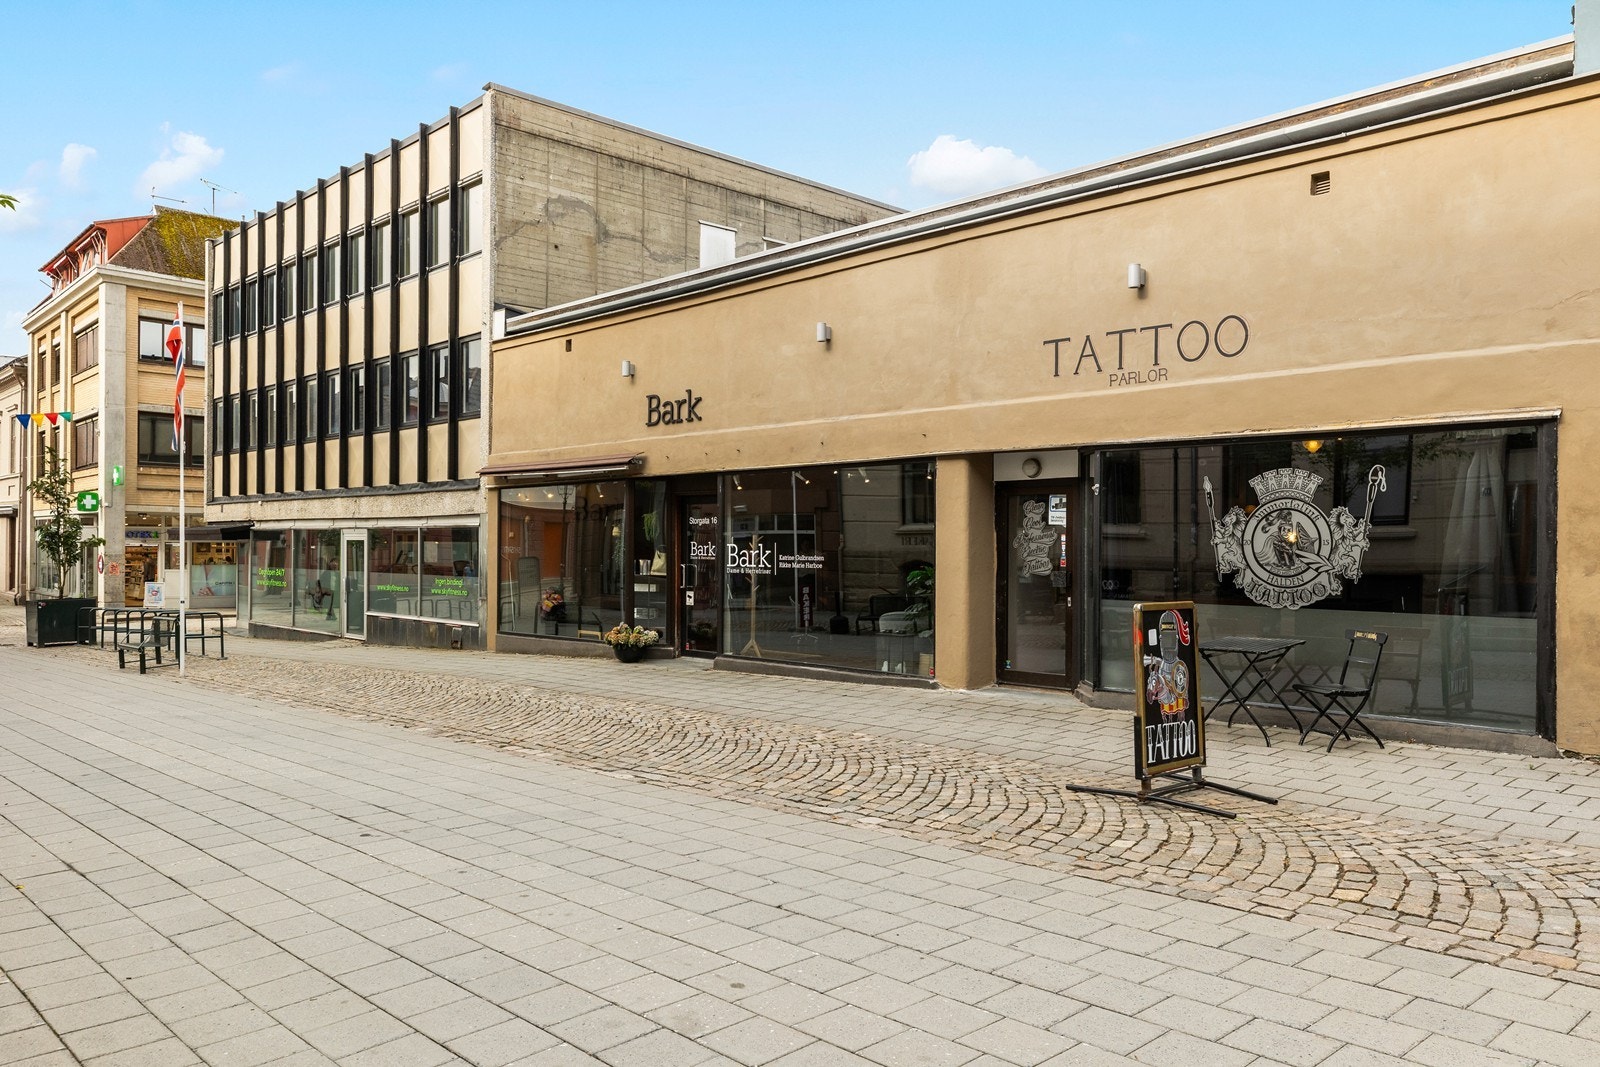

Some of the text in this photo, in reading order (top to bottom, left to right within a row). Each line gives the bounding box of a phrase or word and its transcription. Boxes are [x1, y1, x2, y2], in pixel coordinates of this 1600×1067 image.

[1043, 315, 1249, 377] TATTOO
[1109, 368, 1168, 387] PARLOR
[645, 389, 702, 427] Bark
[689, 516, 718, 526] Storgata 16
[690, 541, 716, 556] Bark
[726, 543, 772, 568] Bark
[1266, 574, 1305, 585] HALDEN
[1246, 577, 1328, 608] TATTOO
[1145, 719, 1196, 764] TATTOO
